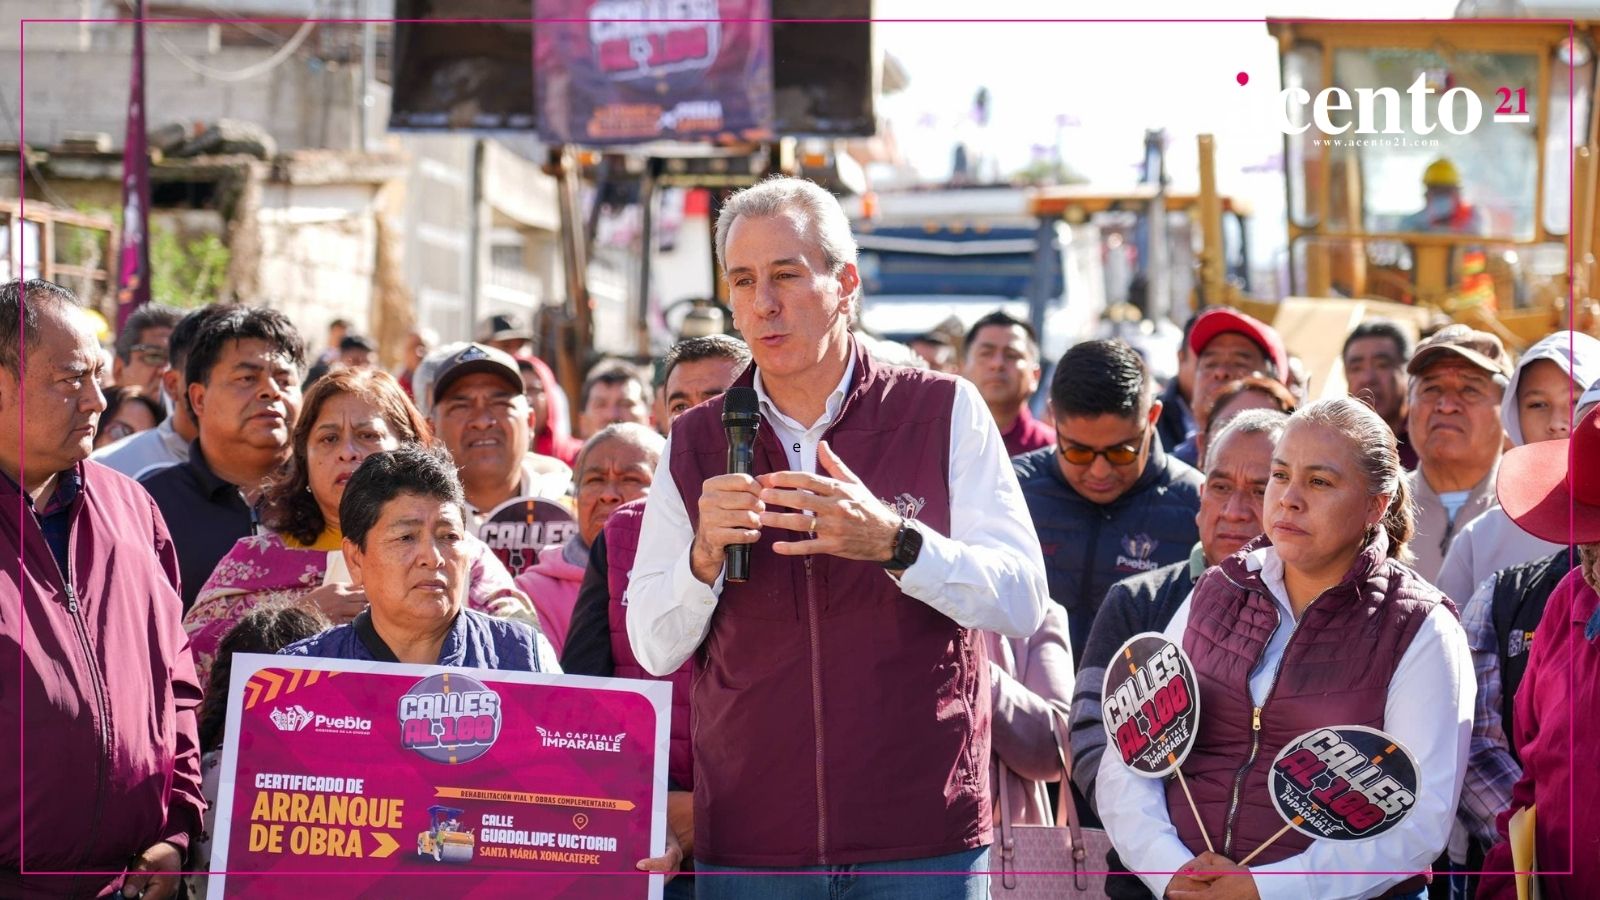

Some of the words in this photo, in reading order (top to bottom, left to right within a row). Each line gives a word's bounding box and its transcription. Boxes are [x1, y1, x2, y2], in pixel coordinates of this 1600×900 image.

[1103, 643, 1182, 736] CALLES
[399, 691, 499, 721] CALLES
[1116, 715, 1151, 764] AL
[1141, 673, 1189, 738] 100
[315, 714, 372, 731] Puebla
[403, 718, 438, 747] AL
[439, 715, 497, 744] 100
[547, 730, 561, 738] LA
[566, 732, 613, 741] CAPITAL
[542, 737, 621, 752] IMPARABLE
[1149, 729, 1190, 769] IMPARABLE
[255, 773, 345, 793] CERTIFICADO
[345, 778, 364, 794] DE
[1301, 731, 1416, 816] CALLES
[461, 790, 511, 801] REHABILITACIÓN
[513, 793, 528, 802] VIAL
[529, 794, 534, 803] Y
[535, 796, 557, 805] OBRAS
[557, 797, 616, 808] COMPLEMENTARIAS
[1274, 748, 1329, 793] AL
[1311, 775, 1386, 831] 100
[250, 791, 405, 829] ARRANQUE
[481, 813, 514, 828] CALLE
[1280, 792, 1334, 837] IMPARABLE
[249, 823, 285, 854] DE
[289, 825, 364, 859] OBRA
[479, 846, 508, 859] SANTA
[540, 851, 600, 865] XONACATEPEC
[480, 829, 555, 847] GUADALUPE
[557, 833, 617, 852] VICTORIA
